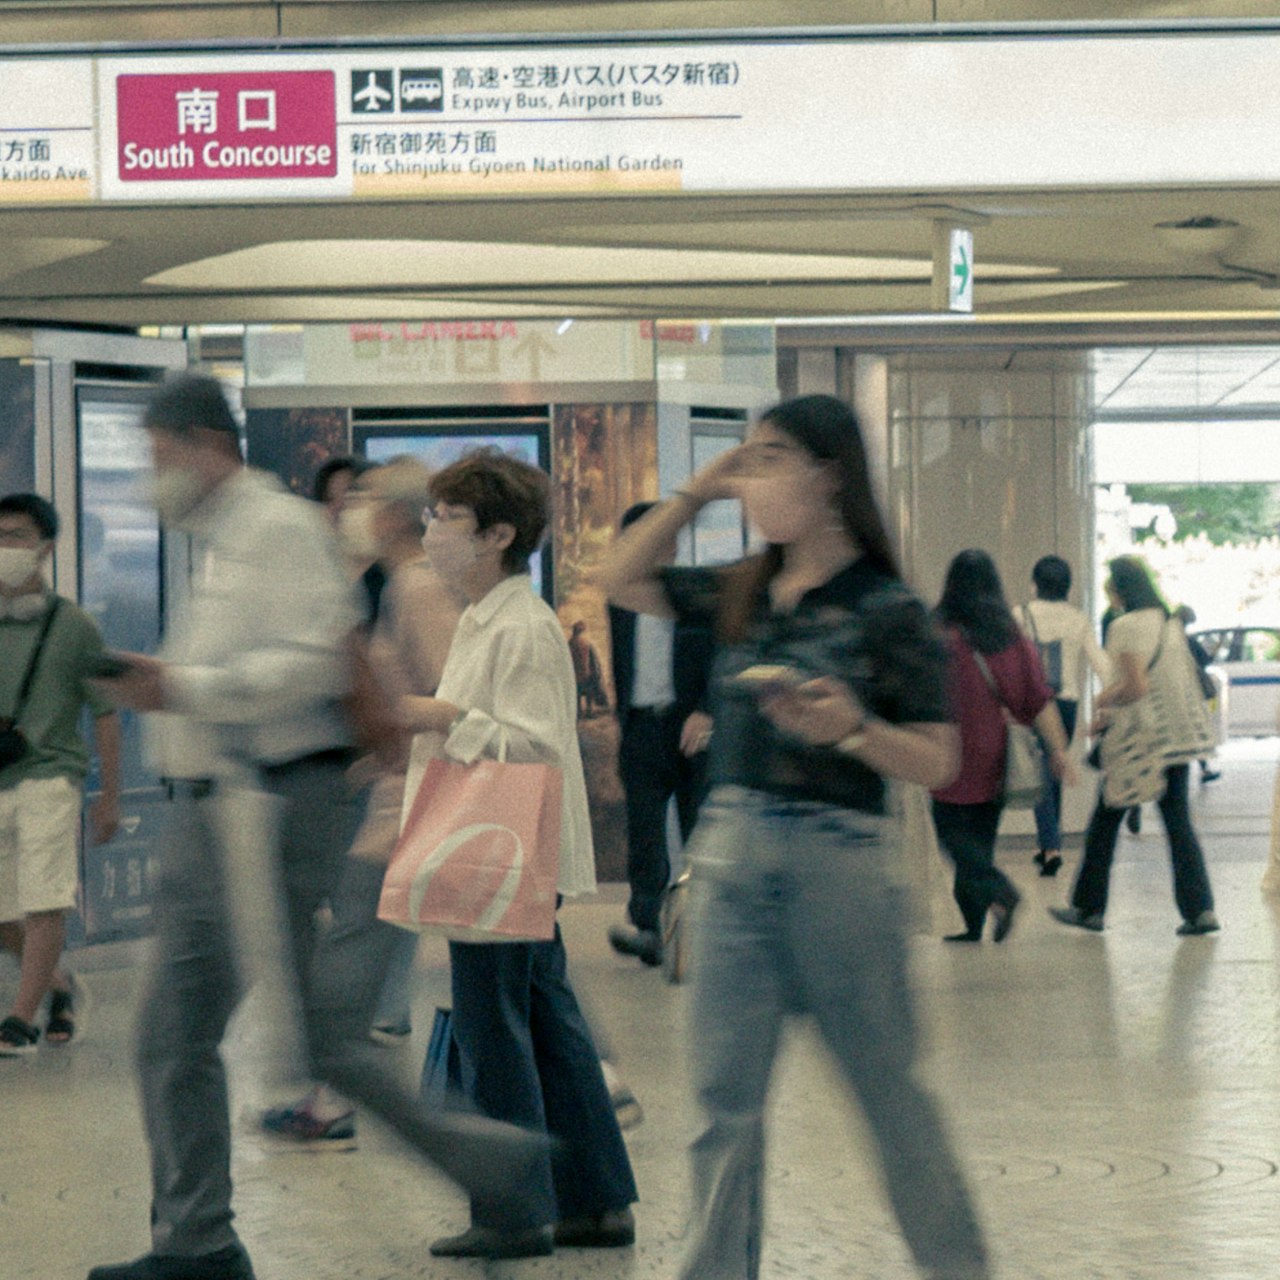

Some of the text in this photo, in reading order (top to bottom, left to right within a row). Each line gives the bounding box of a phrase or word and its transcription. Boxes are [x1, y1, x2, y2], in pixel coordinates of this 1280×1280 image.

[175, 87, 277, 135] 南口
[451, 91, 663, 112] Expwy Bus, Airport Bus
[0, 138, 51, 162] 方面
[123, 140, 332, 170] South Concourse
[350, 130, 498, 157] 新宿御苑方面
[351, 155, 685, 178] for Shinjuku Gyoen National Garden
